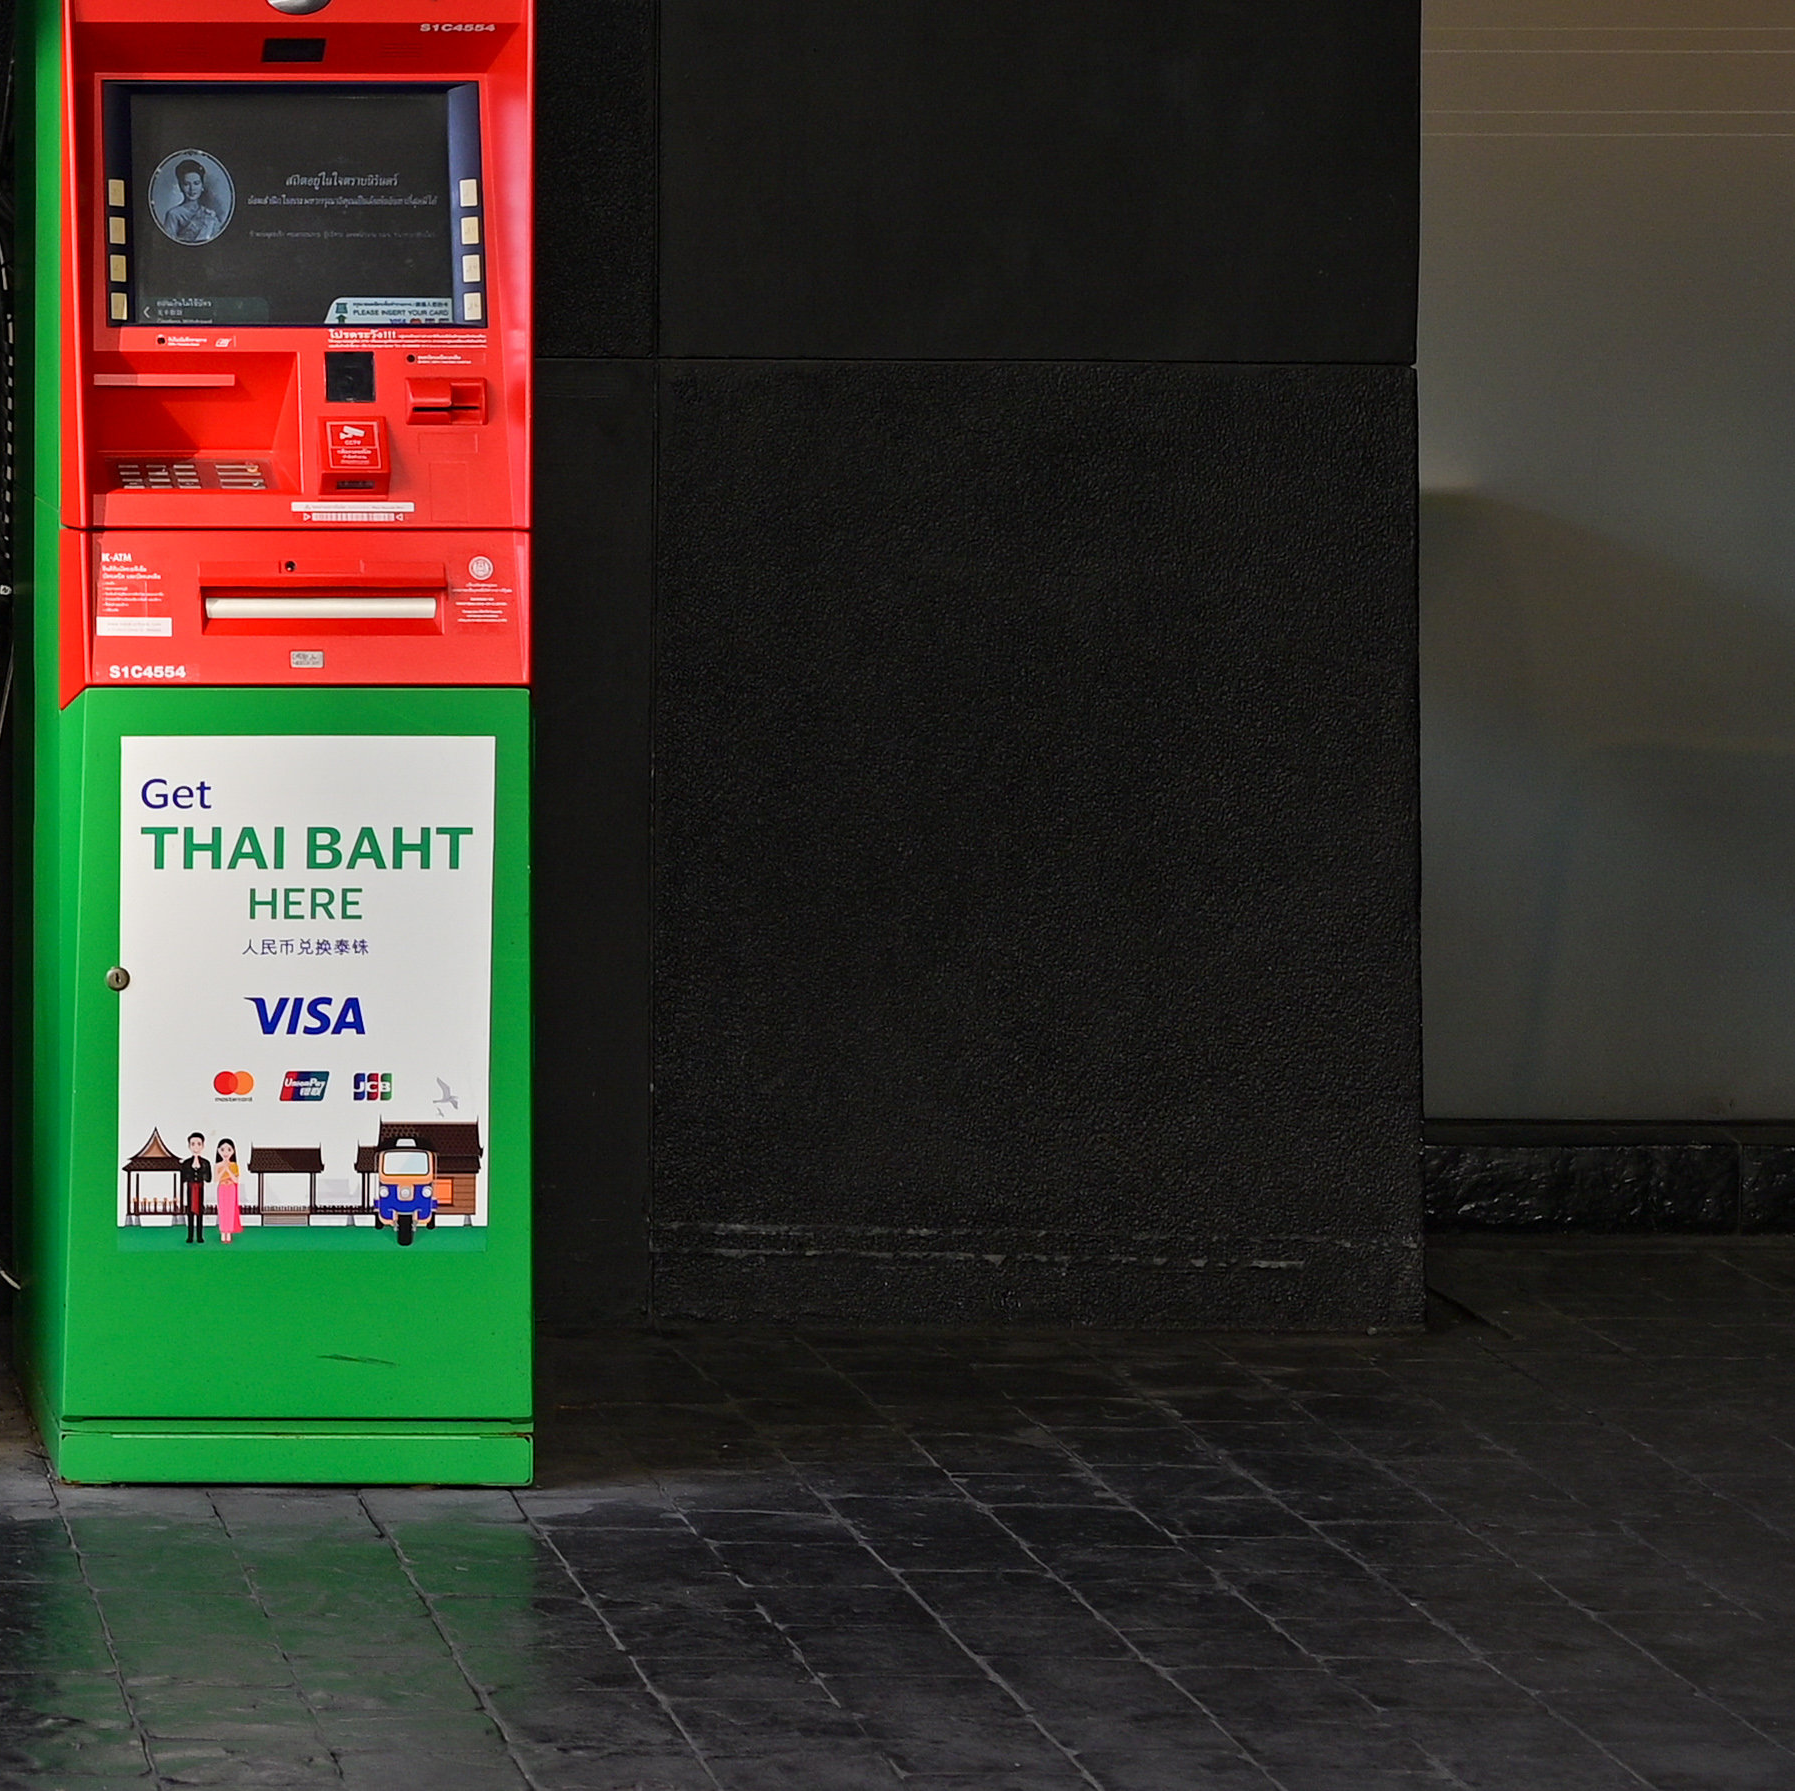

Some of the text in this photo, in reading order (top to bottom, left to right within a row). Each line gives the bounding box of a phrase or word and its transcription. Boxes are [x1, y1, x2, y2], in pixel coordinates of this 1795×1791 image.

[420, 23, 496, 32] S1C4554
[110, 665, 186, 678] S1C4554
[141, 778, 212, 810] Get
[141, 826, 473, 870] THAI BAHT
[249, 888, 363, 919] HERE
[242, 939, 370, 956] 人民币兑换泰铢
[243, 997, 366, 1035] VISA
[284, 1078, 325, 1089] UnionPay
[353, 1081, 390, 1092] JCB
